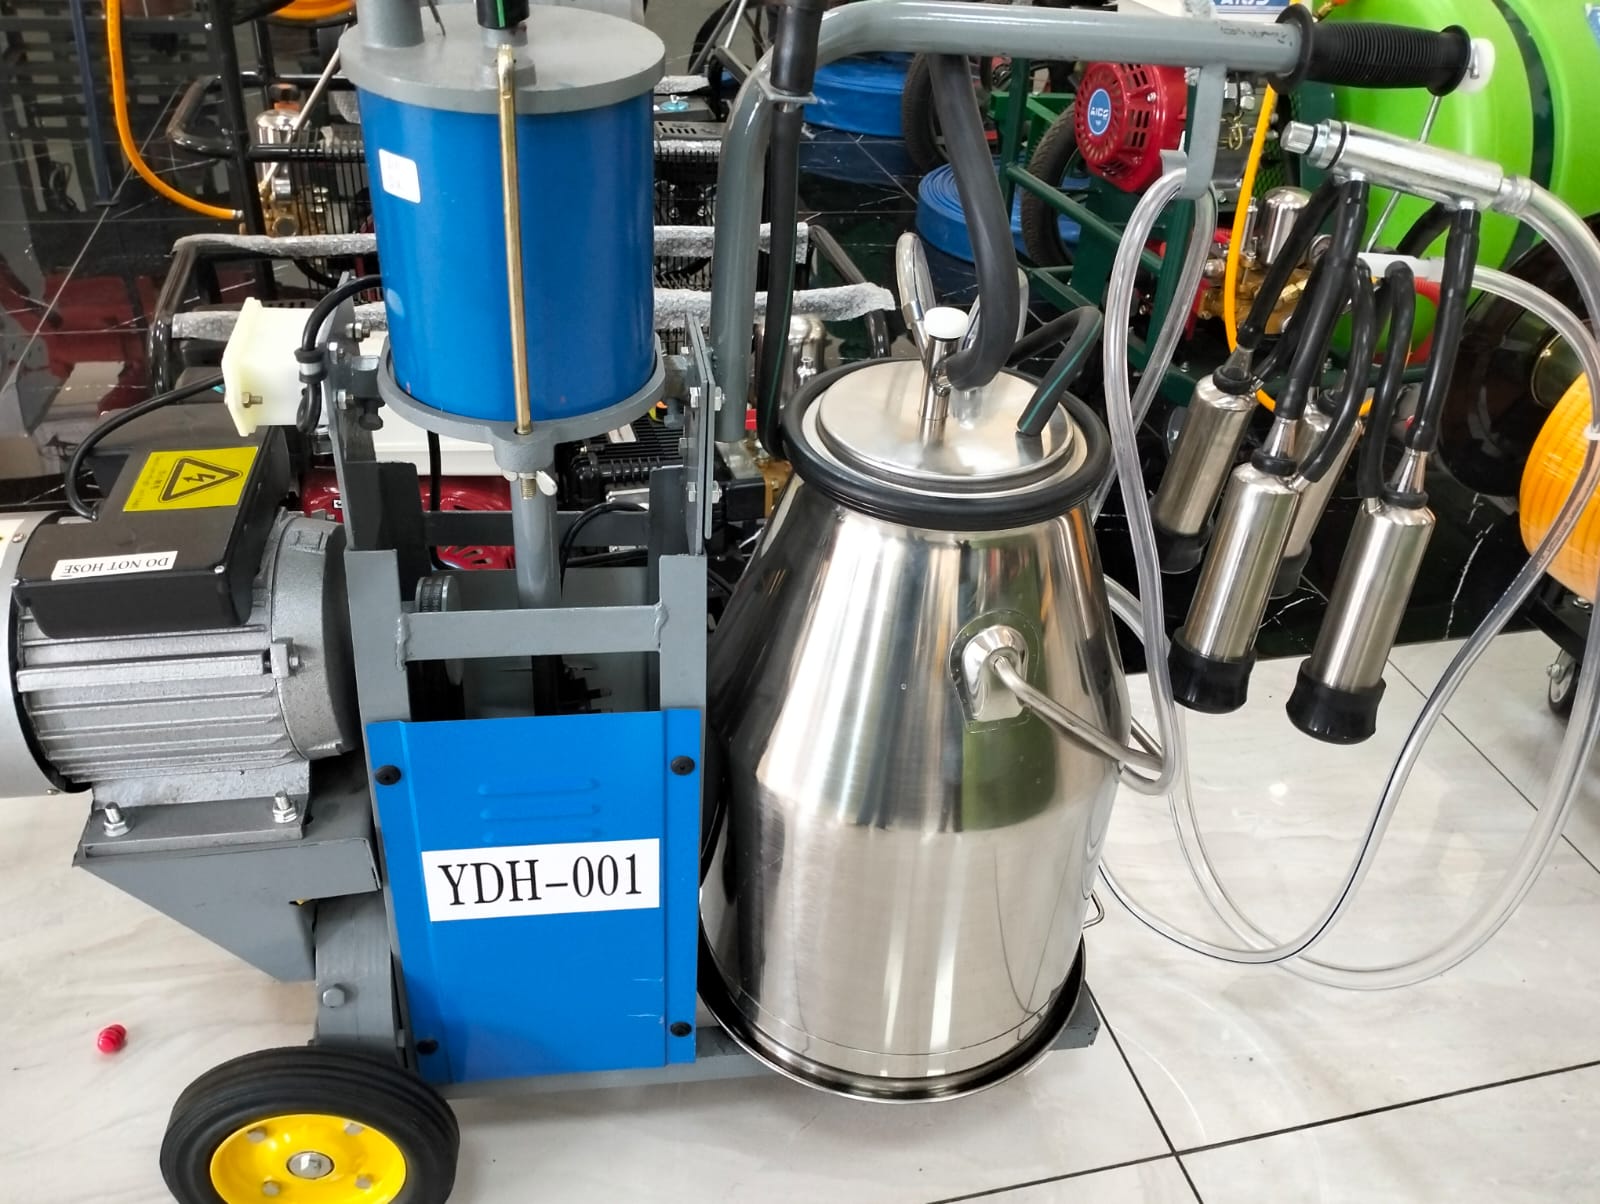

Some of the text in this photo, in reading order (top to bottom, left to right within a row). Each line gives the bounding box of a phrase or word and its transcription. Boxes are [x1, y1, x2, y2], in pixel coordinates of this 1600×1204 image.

[64, 557, 170, 575] DO NOT HOSE
[437, 853, 642, 906] YDH-001
